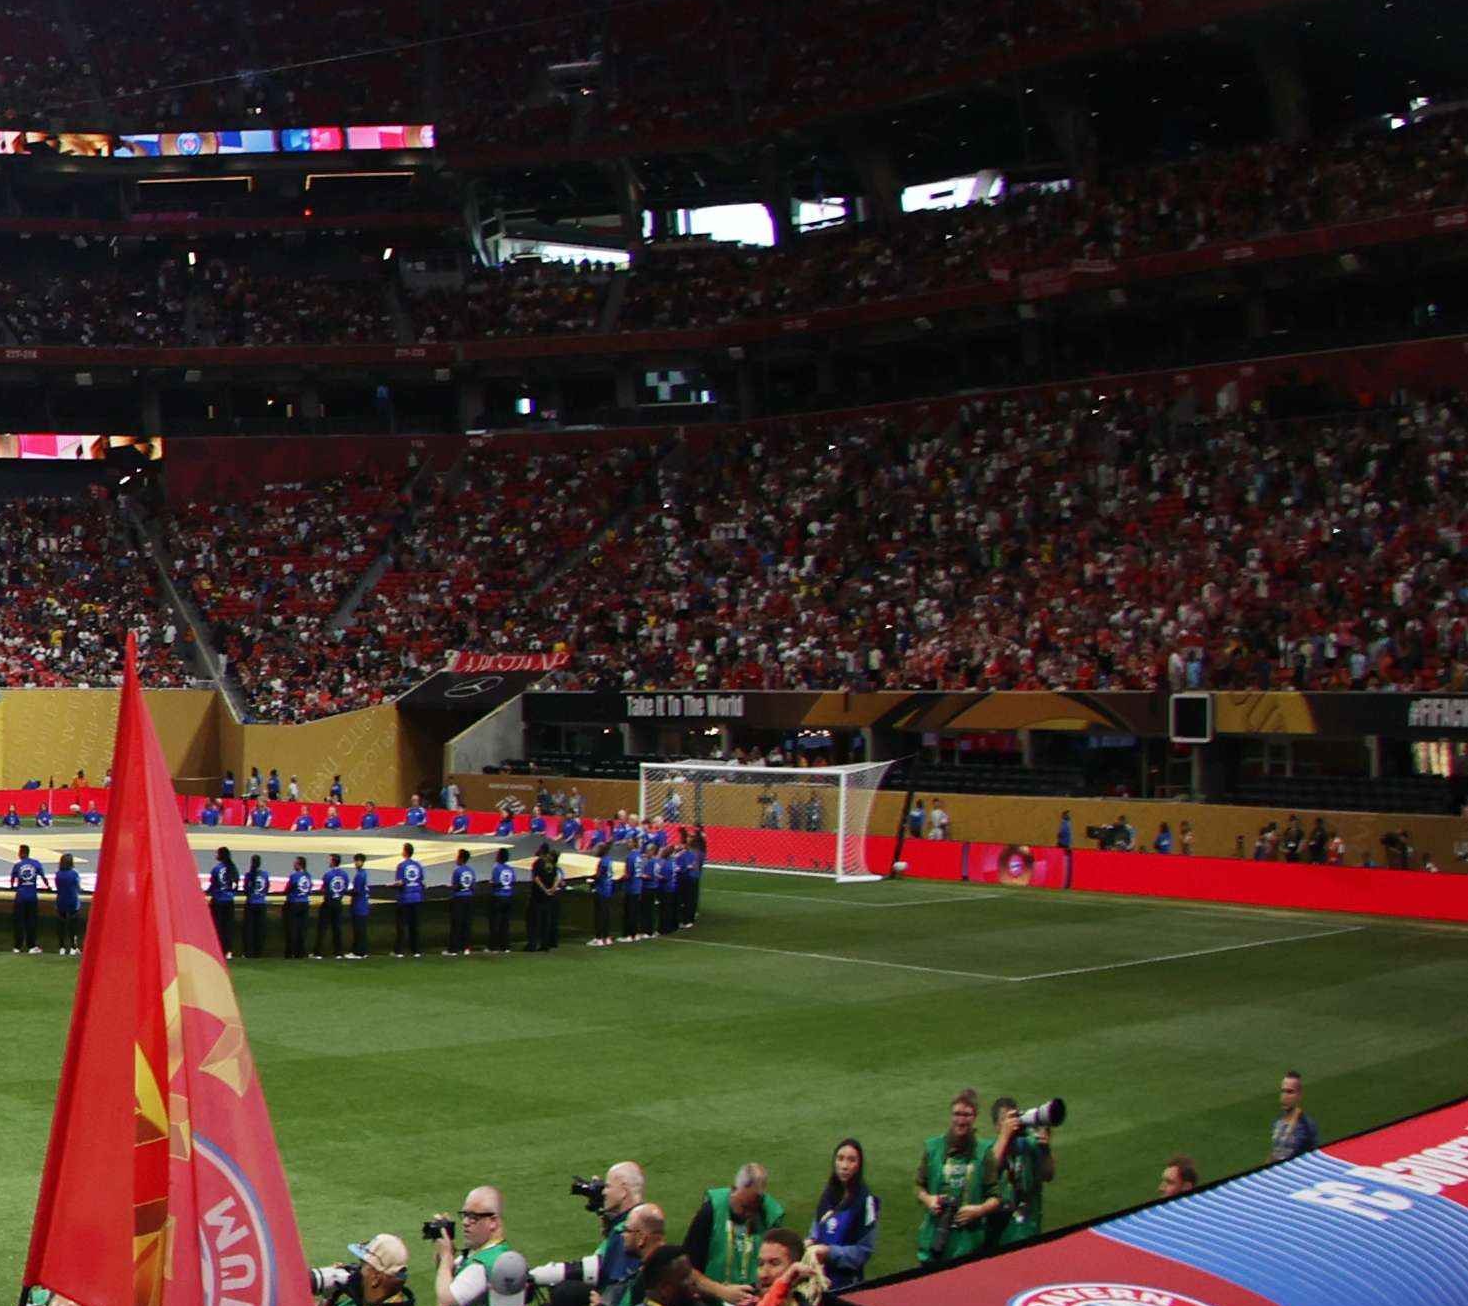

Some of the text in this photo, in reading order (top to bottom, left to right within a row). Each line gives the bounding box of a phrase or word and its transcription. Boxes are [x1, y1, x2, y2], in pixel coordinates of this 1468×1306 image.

[626, 695, 744, 717] Take It To The World
